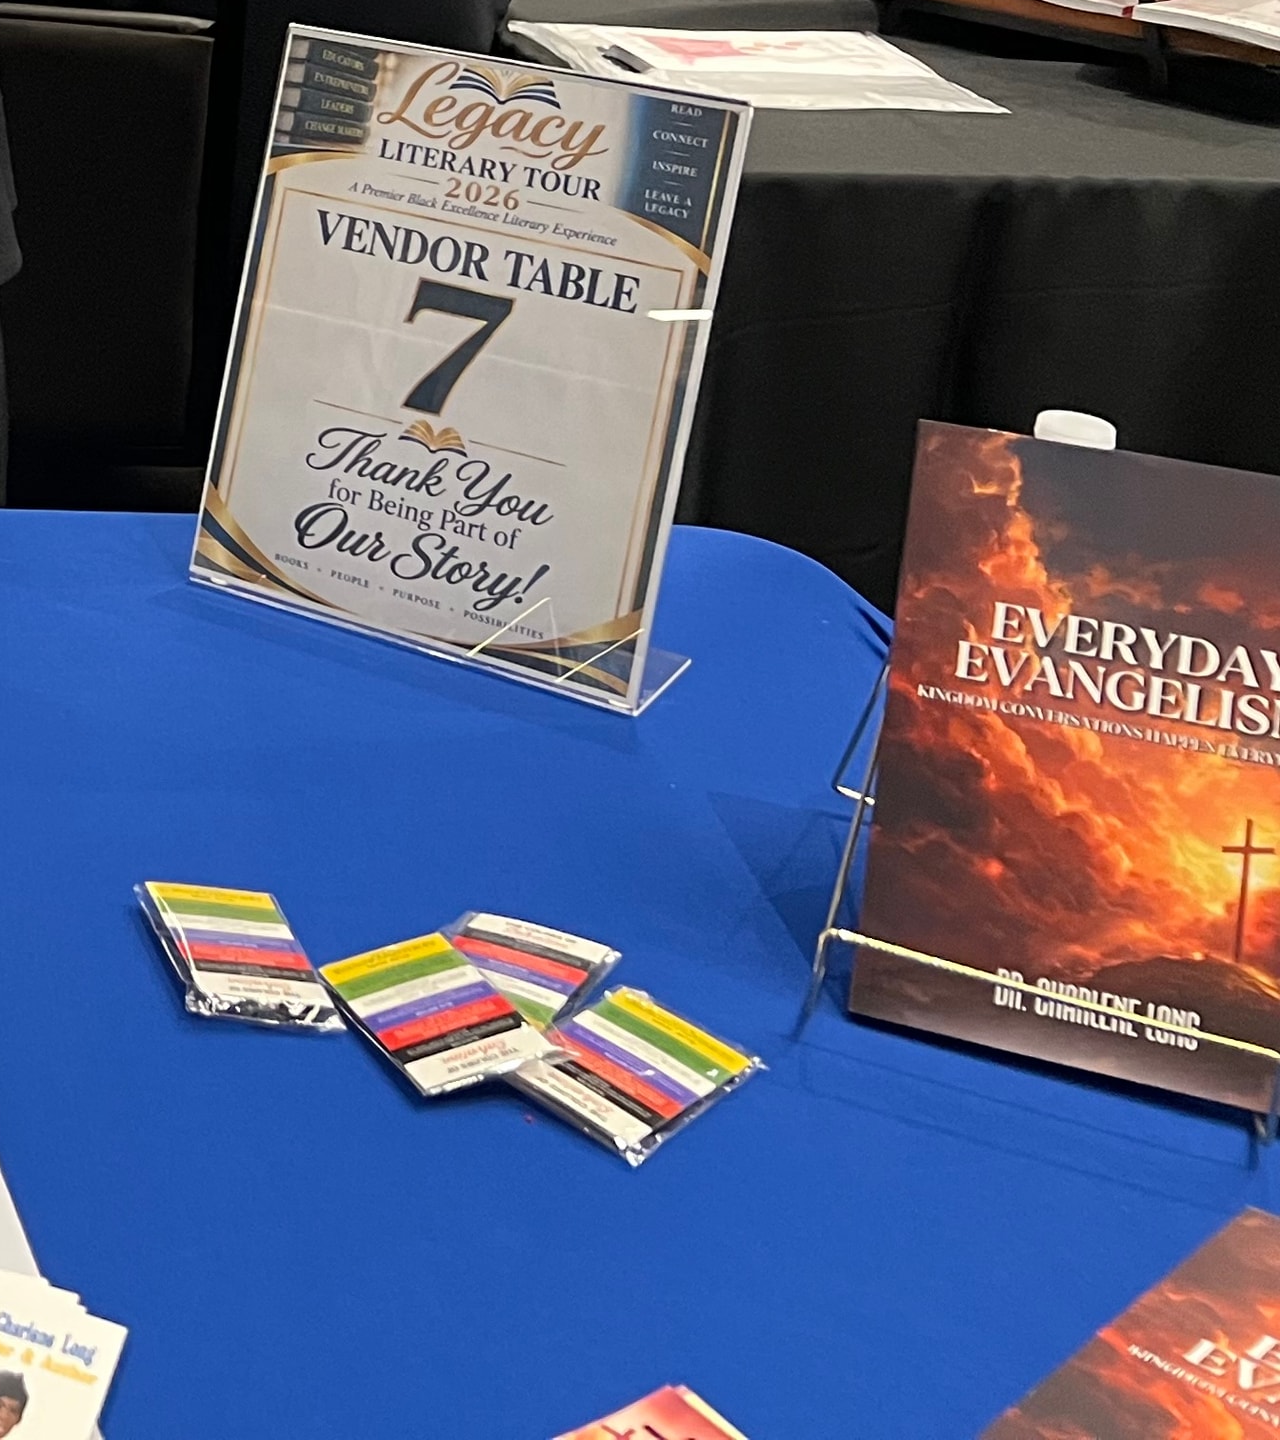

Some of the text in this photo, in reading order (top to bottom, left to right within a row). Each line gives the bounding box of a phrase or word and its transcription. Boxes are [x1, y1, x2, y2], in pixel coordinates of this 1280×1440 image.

[321, 99, 354, 115] LEADERS
[376, 60, 609, 171] Legacy
[671, 104, 702, 117] READ
[378, 137, 602, 202] LITERARY TOUR
[652, 130, 708, 148] CONNECT
[652, 161, 698, 177] INSPIRE
[348, 182, 618, 247] A Premier Black Excellence Literary Experience
[444, 177, 520, 211] 2026
[644, 189, 680, 205] LEAVE
[644, 203, 689, 219] LEGACY
[317, 209, 641, 314] VENDOR TABLE
[401, 276, 517, 417] 7
[305, 427, 554, 525] Thank You
[328, 478, 522, 550] for Being Part of
[274, 553, 309, 571] BOOKS
[330, 569, 370, 589] PEOPLE
[392, 588, 441, 610] PURPOSE
[294, 502, 550, 612] Our Story!
[917, 683, 1215, 753] KINGDOM CONVERSATIONS HAPPEN
[61, 1334, 98, 1366] Long
